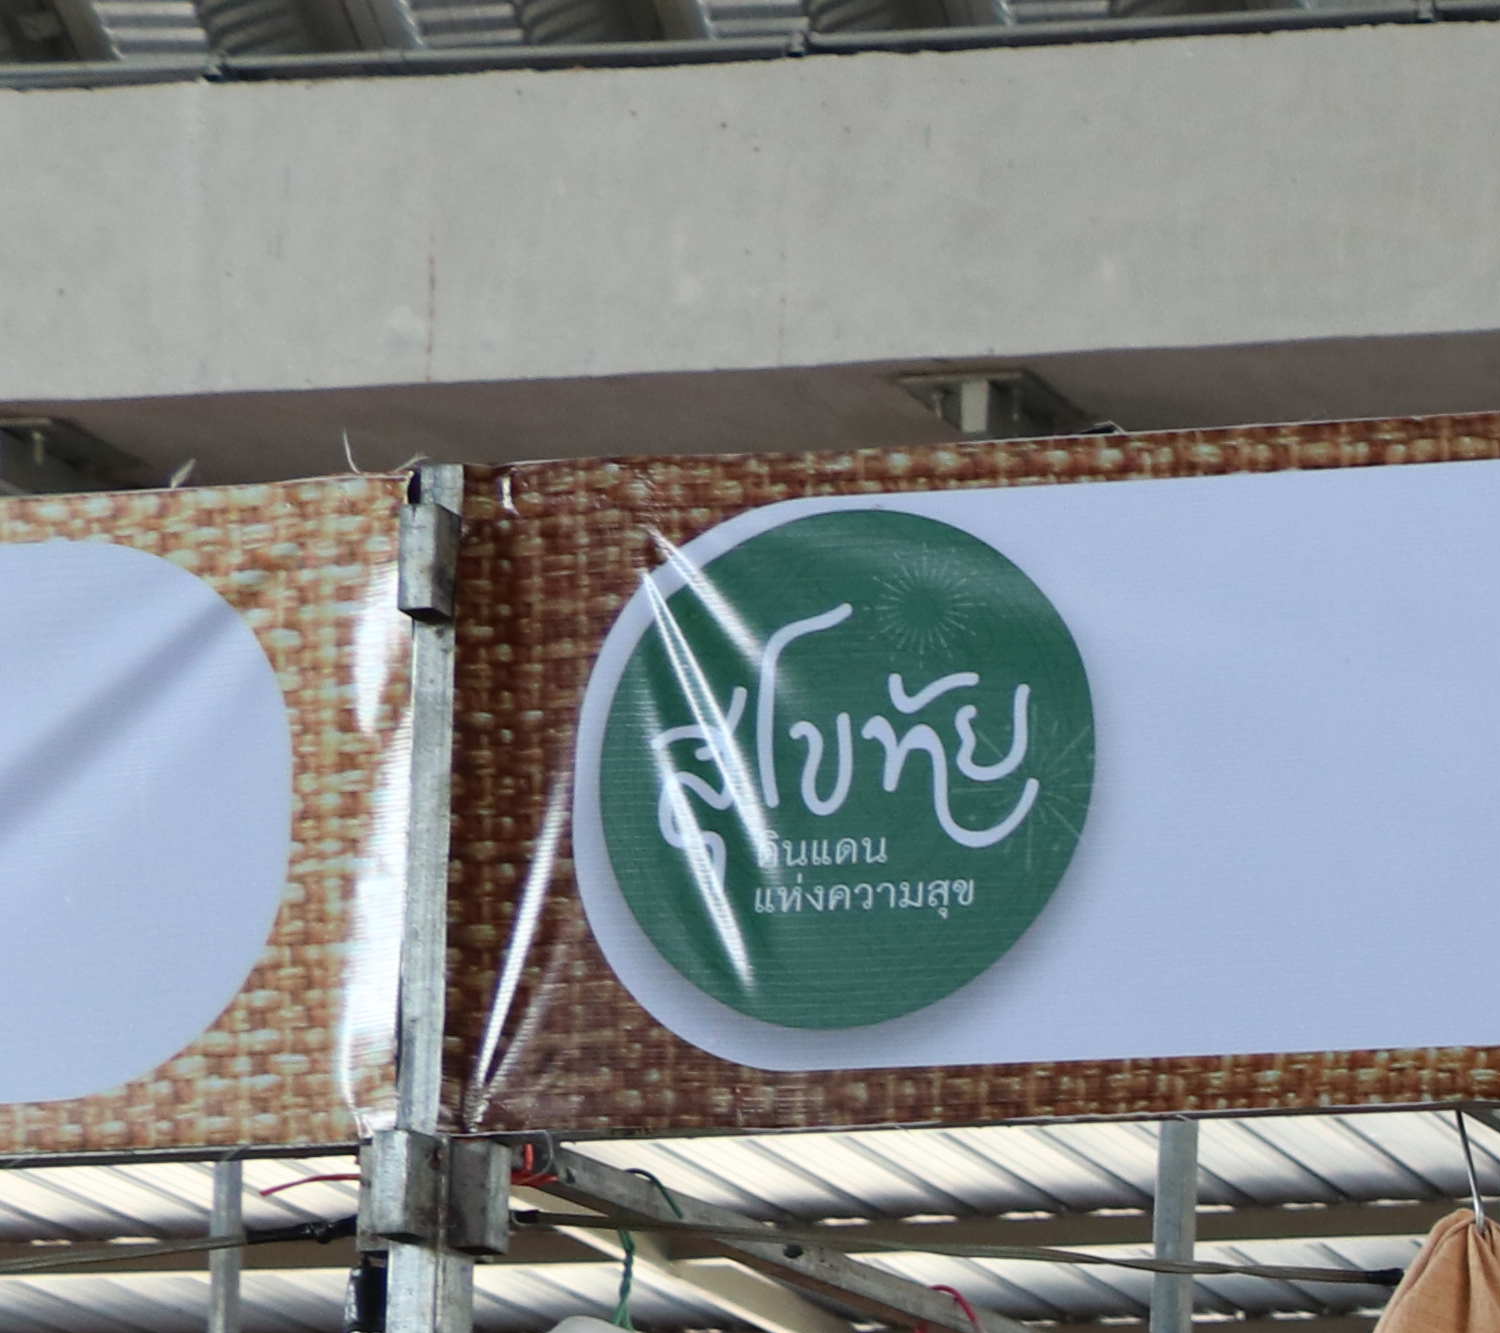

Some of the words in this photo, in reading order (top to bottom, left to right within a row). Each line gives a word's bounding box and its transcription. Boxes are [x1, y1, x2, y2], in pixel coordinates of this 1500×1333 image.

[651, 602, 1040, 893] สุโขทัย
[757, 827, 889, 869] ดินแดน
[753, 876, 976, 919] แห่งความสุข
